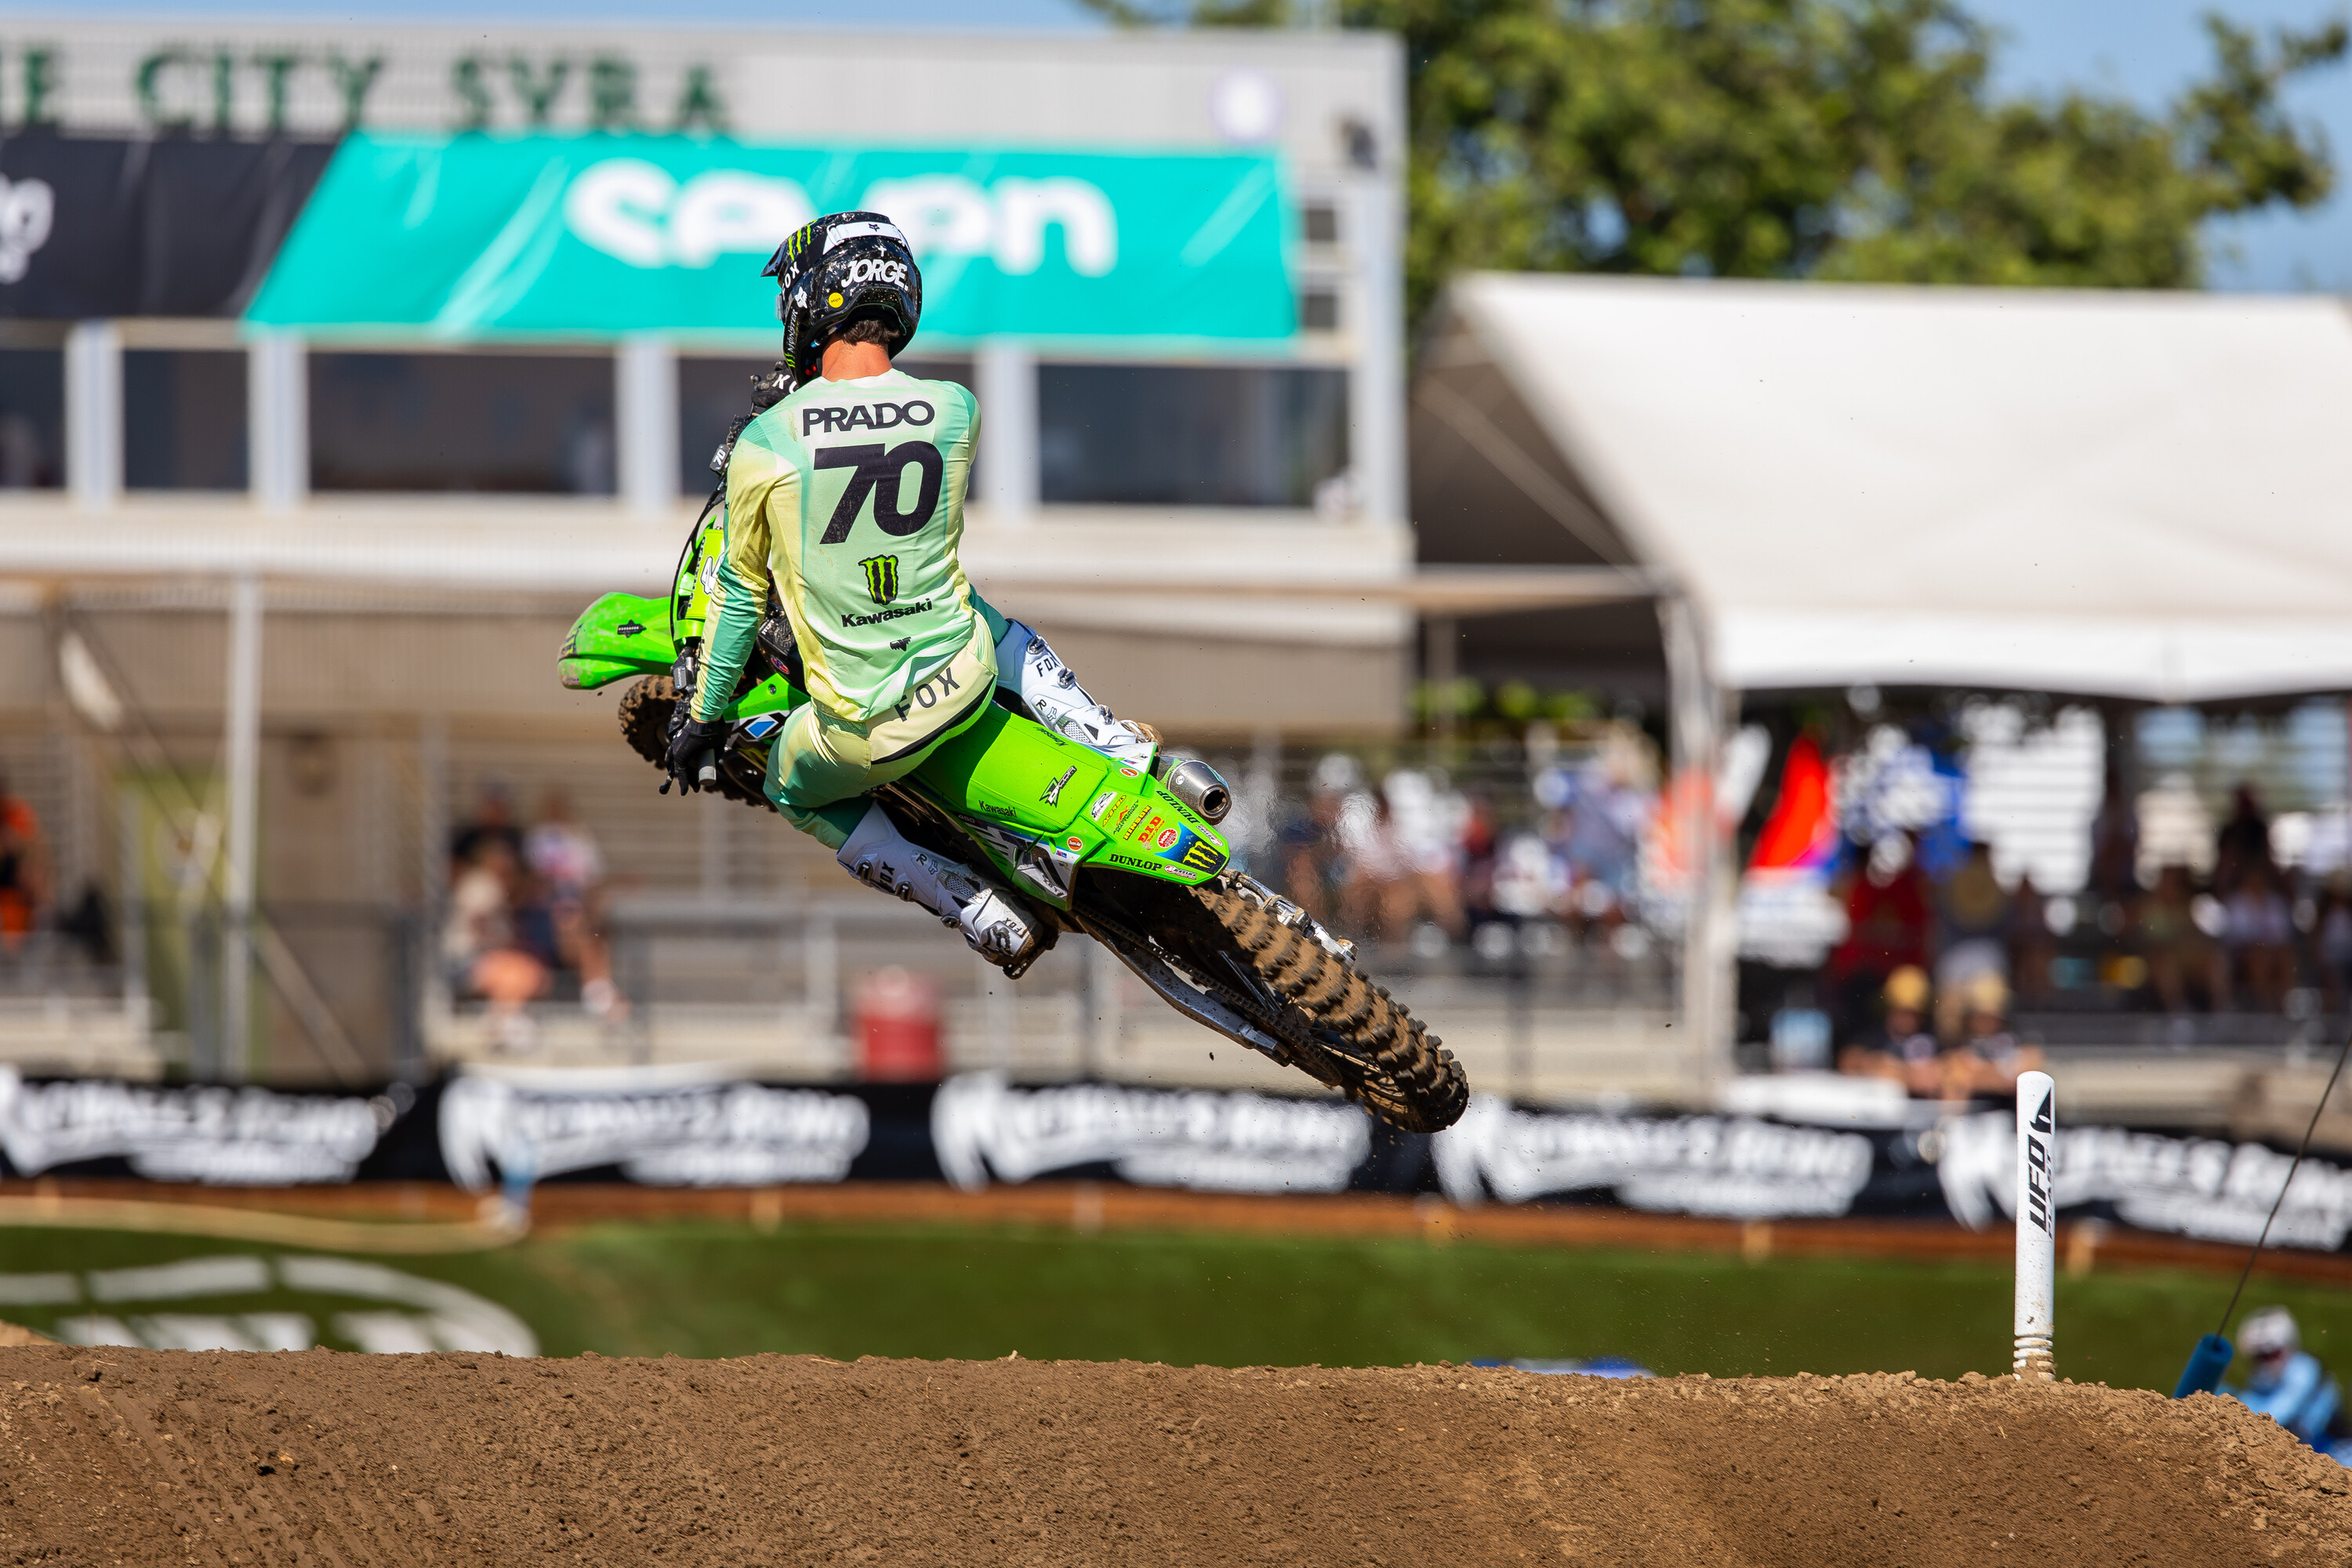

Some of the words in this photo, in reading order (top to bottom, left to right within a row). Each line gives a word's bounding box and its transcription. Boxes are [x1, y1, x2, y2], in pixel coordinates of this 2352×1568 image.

[136, 52, 383, 129] CITY
[563, 158, 1120, 278] seen
[787, 309, 798, 354] MONSTER
[803, 400, 935, 437] PRADO
[713, 448, 726, 466] 70
[813, 441, 944, 545] 70
[841, 598, 933, 628] Kawasaki
[895, 667, 960, 722] FOX
[1036, 699, 1047, 710] 70
[978, 800, 1018, 818] Kawasaki
[1123, 805, 1152, 840] HINSON
[1156, 790, 1200, 824] DUNLOP
[1109, 854, 1163, 871] DUNLOP
[2028, 1134, 2047, 1232] UFO
